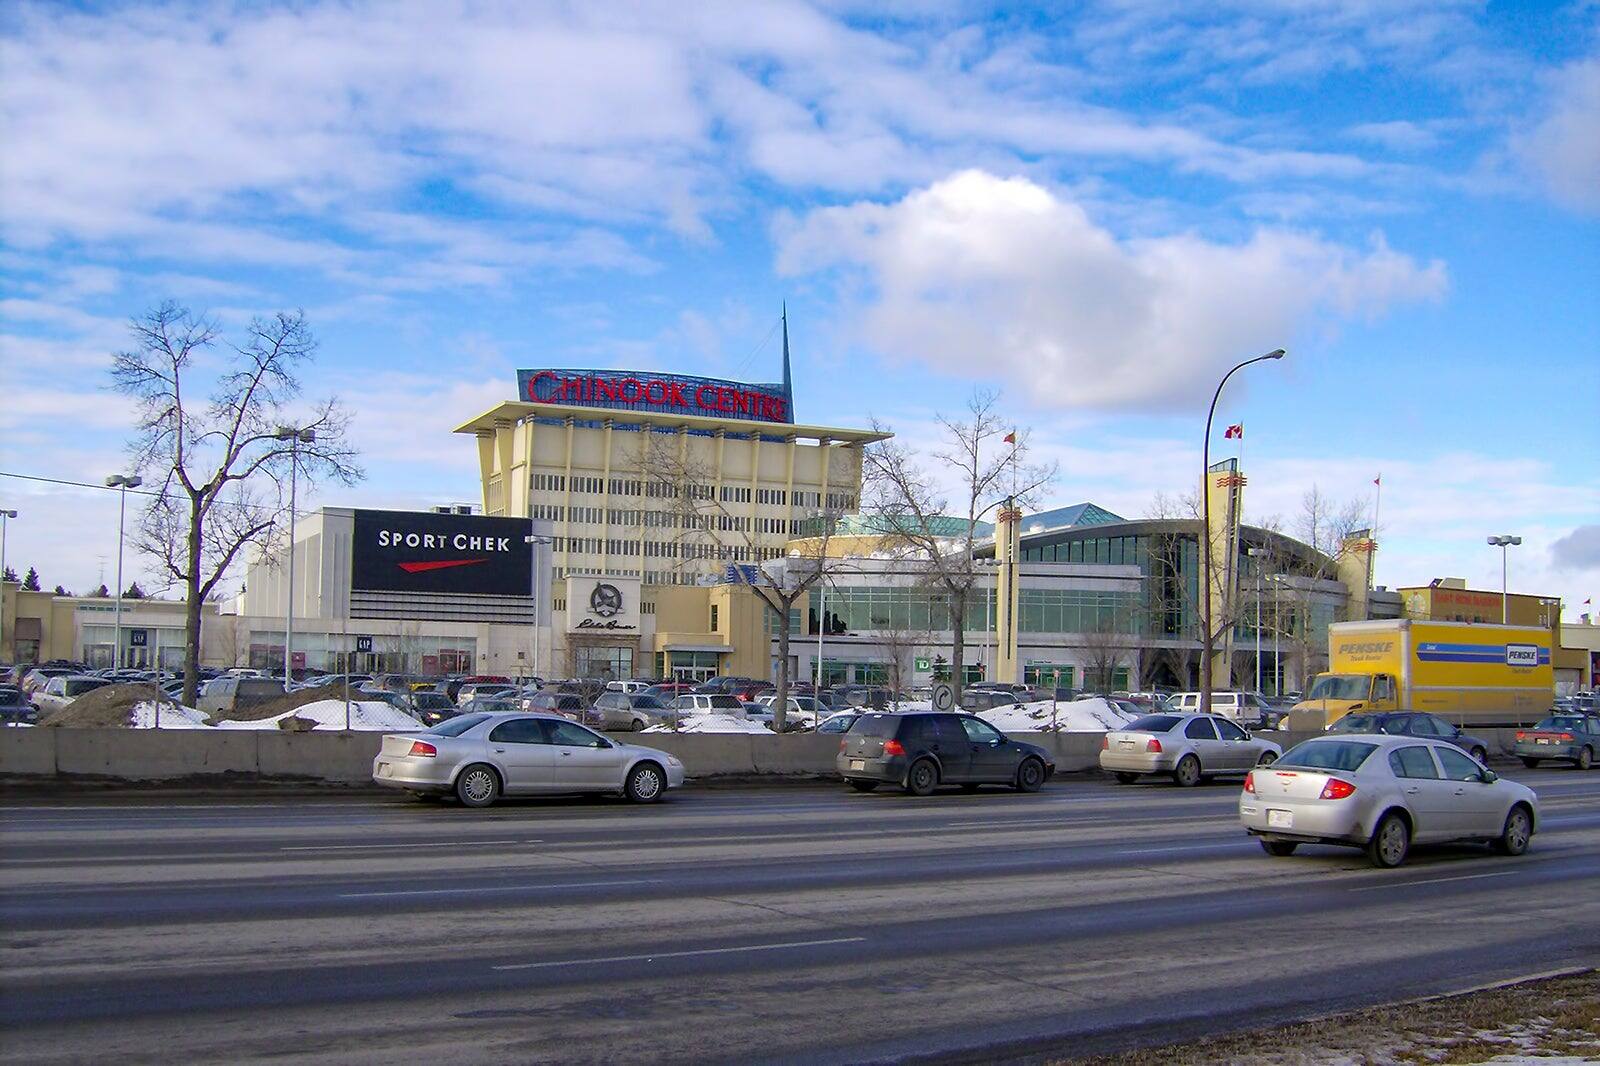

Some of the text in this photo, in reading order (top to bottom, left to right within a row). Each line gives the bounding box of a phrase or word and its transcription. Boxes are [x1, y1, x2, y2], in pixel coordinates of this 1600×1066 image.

[528, 371, 786, 422] CHINOOK CENTRE
[378, 530, 510, 552] SPORT CHEK
[359, 640, 371, 650] GAP
[1339, 642, 1394, 654] PENSKE
[1509, 651, 1536, 660] PENSKE
[917, 660, 929, 669] TD
